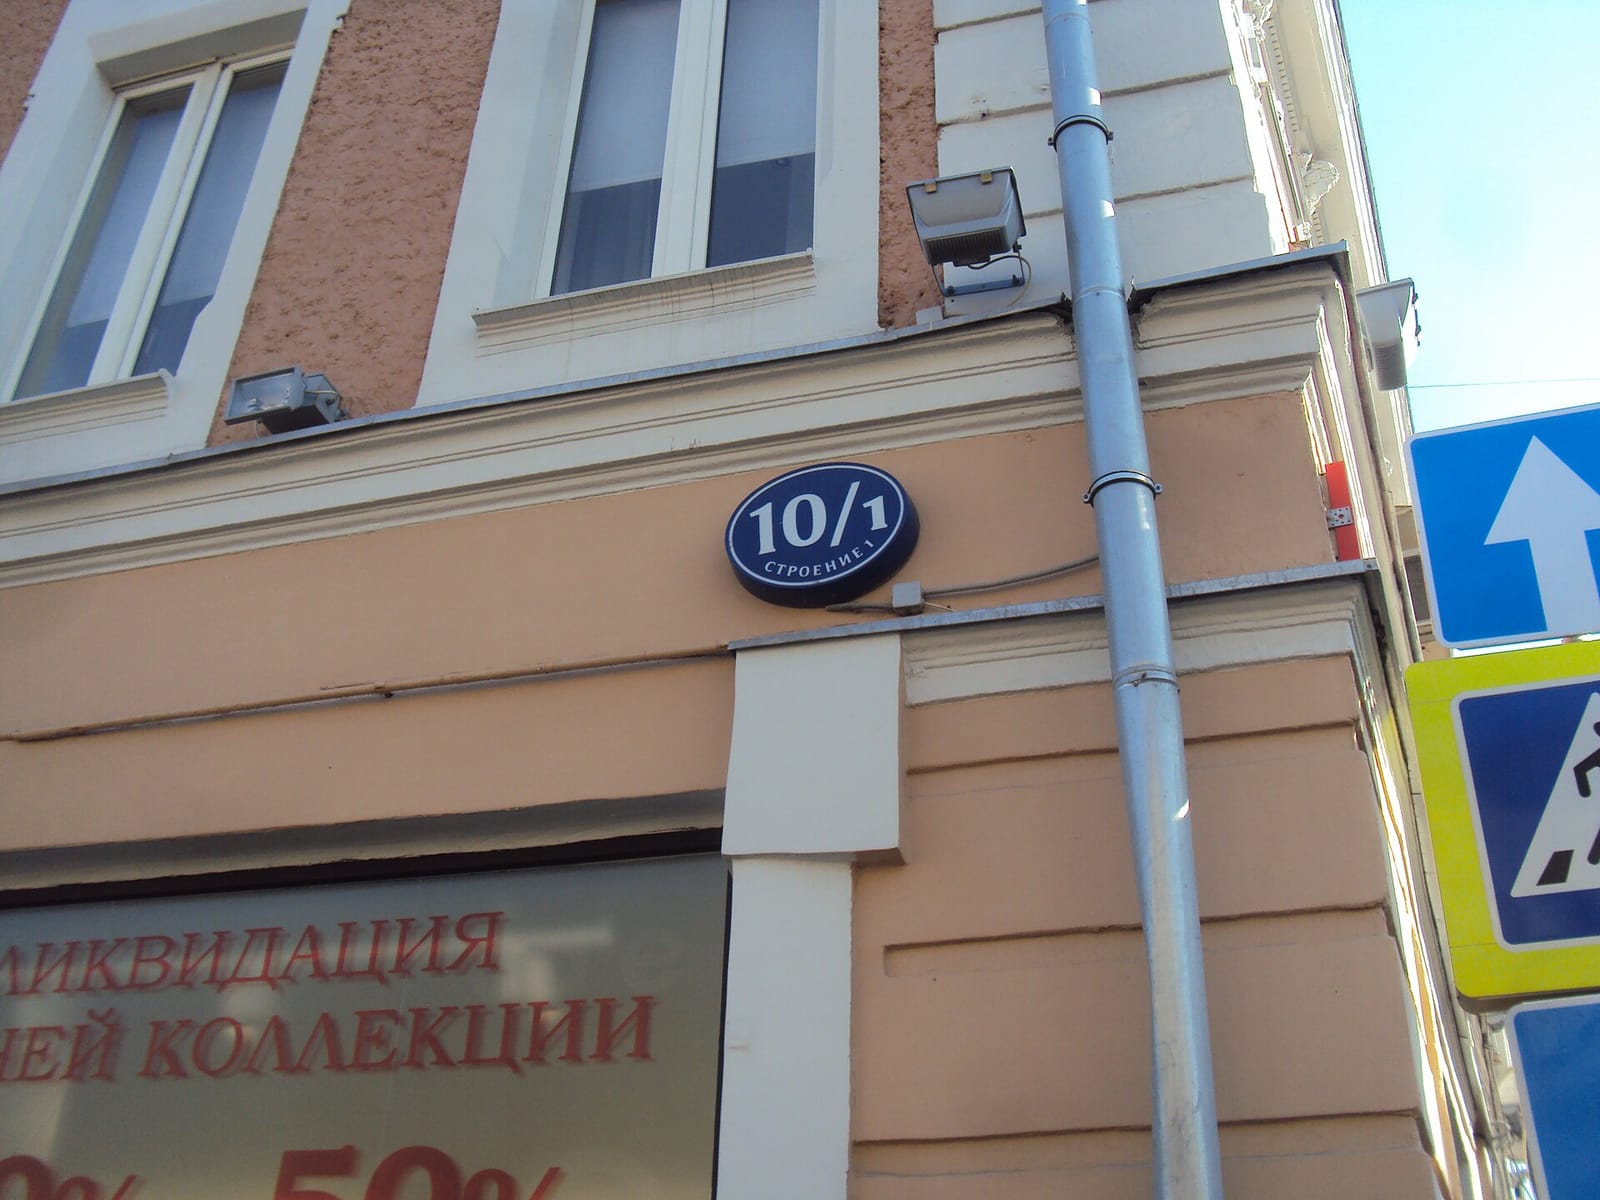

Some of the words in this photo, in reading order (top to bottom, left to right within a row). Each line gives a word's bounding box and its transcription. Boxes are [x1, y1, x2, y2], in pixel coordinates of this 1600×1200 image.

[750, 481, 888, 555] 10/1
[764, 547, 863, 577] СТРОЕНИЕ
[0, 912, 503, 995] ЛИКВИДАЦИЯ
[137, 996, 655, 1077] КОЛЛЕКЦИИ
